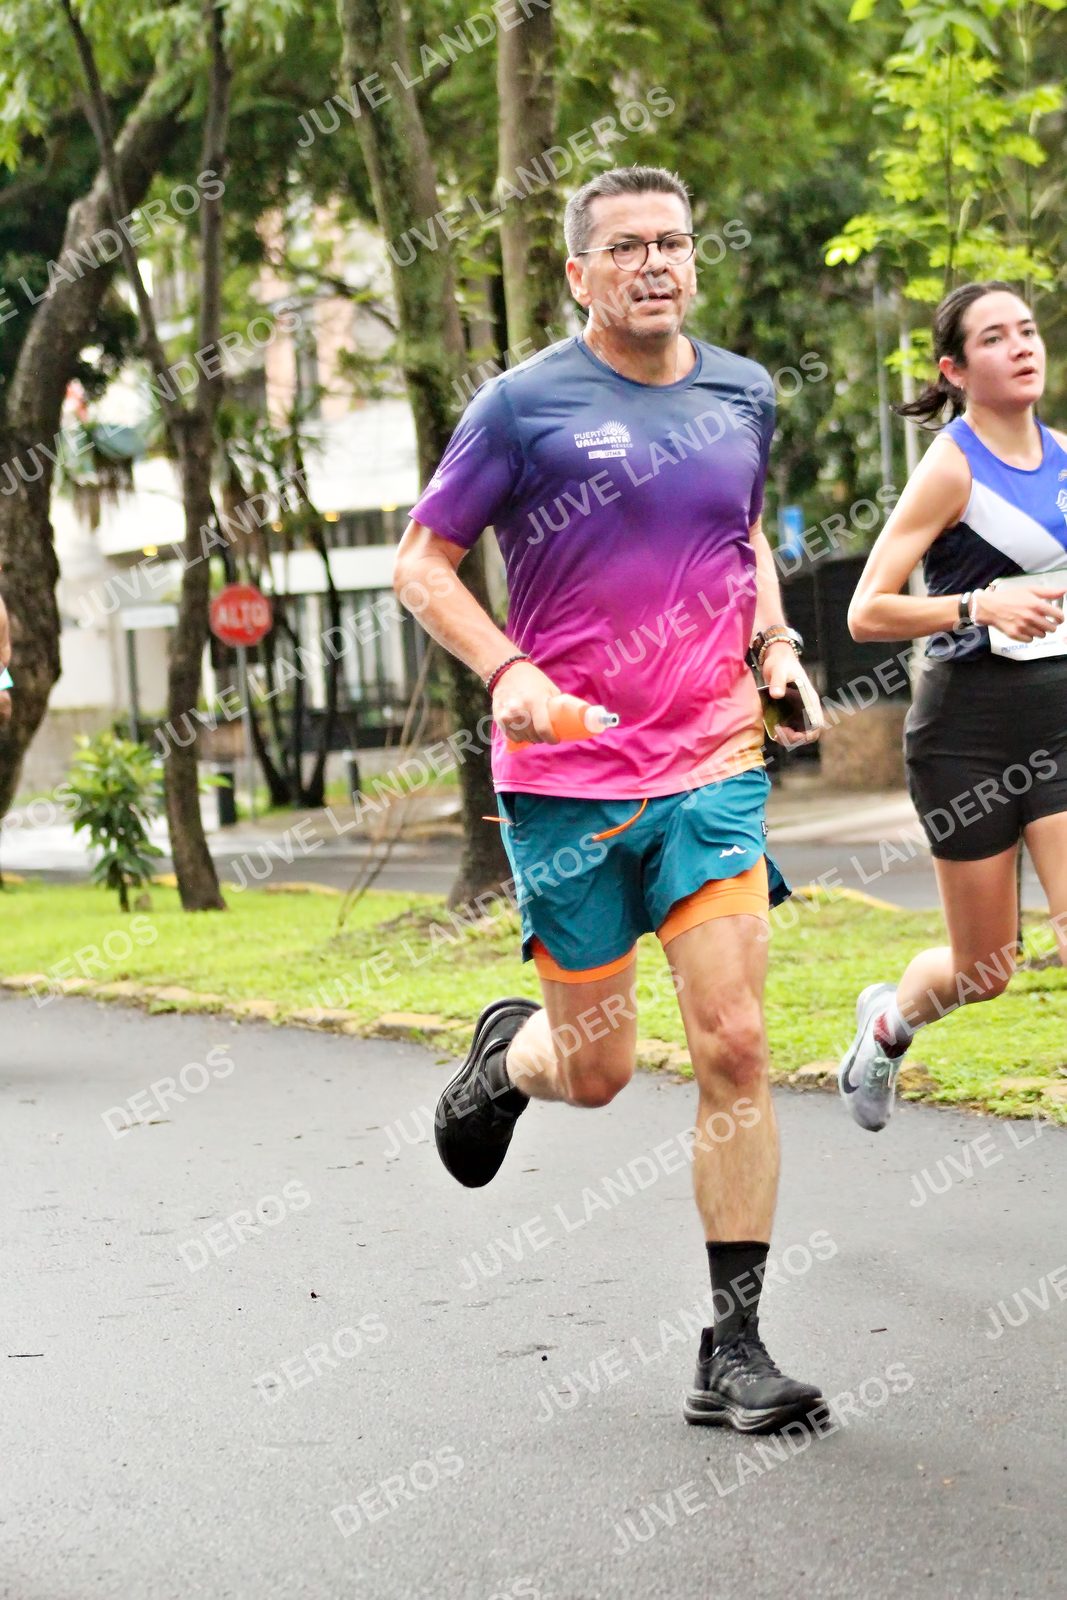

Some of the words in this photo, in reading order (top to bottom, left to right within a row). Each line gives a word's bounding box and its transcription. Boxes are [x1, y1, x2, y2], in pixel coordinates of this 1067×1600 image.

[574, 430, 608, 440] PUERTO
[575, 435, 630, 448] VALLARTA
[218, 602, 269, 627] ALTO
